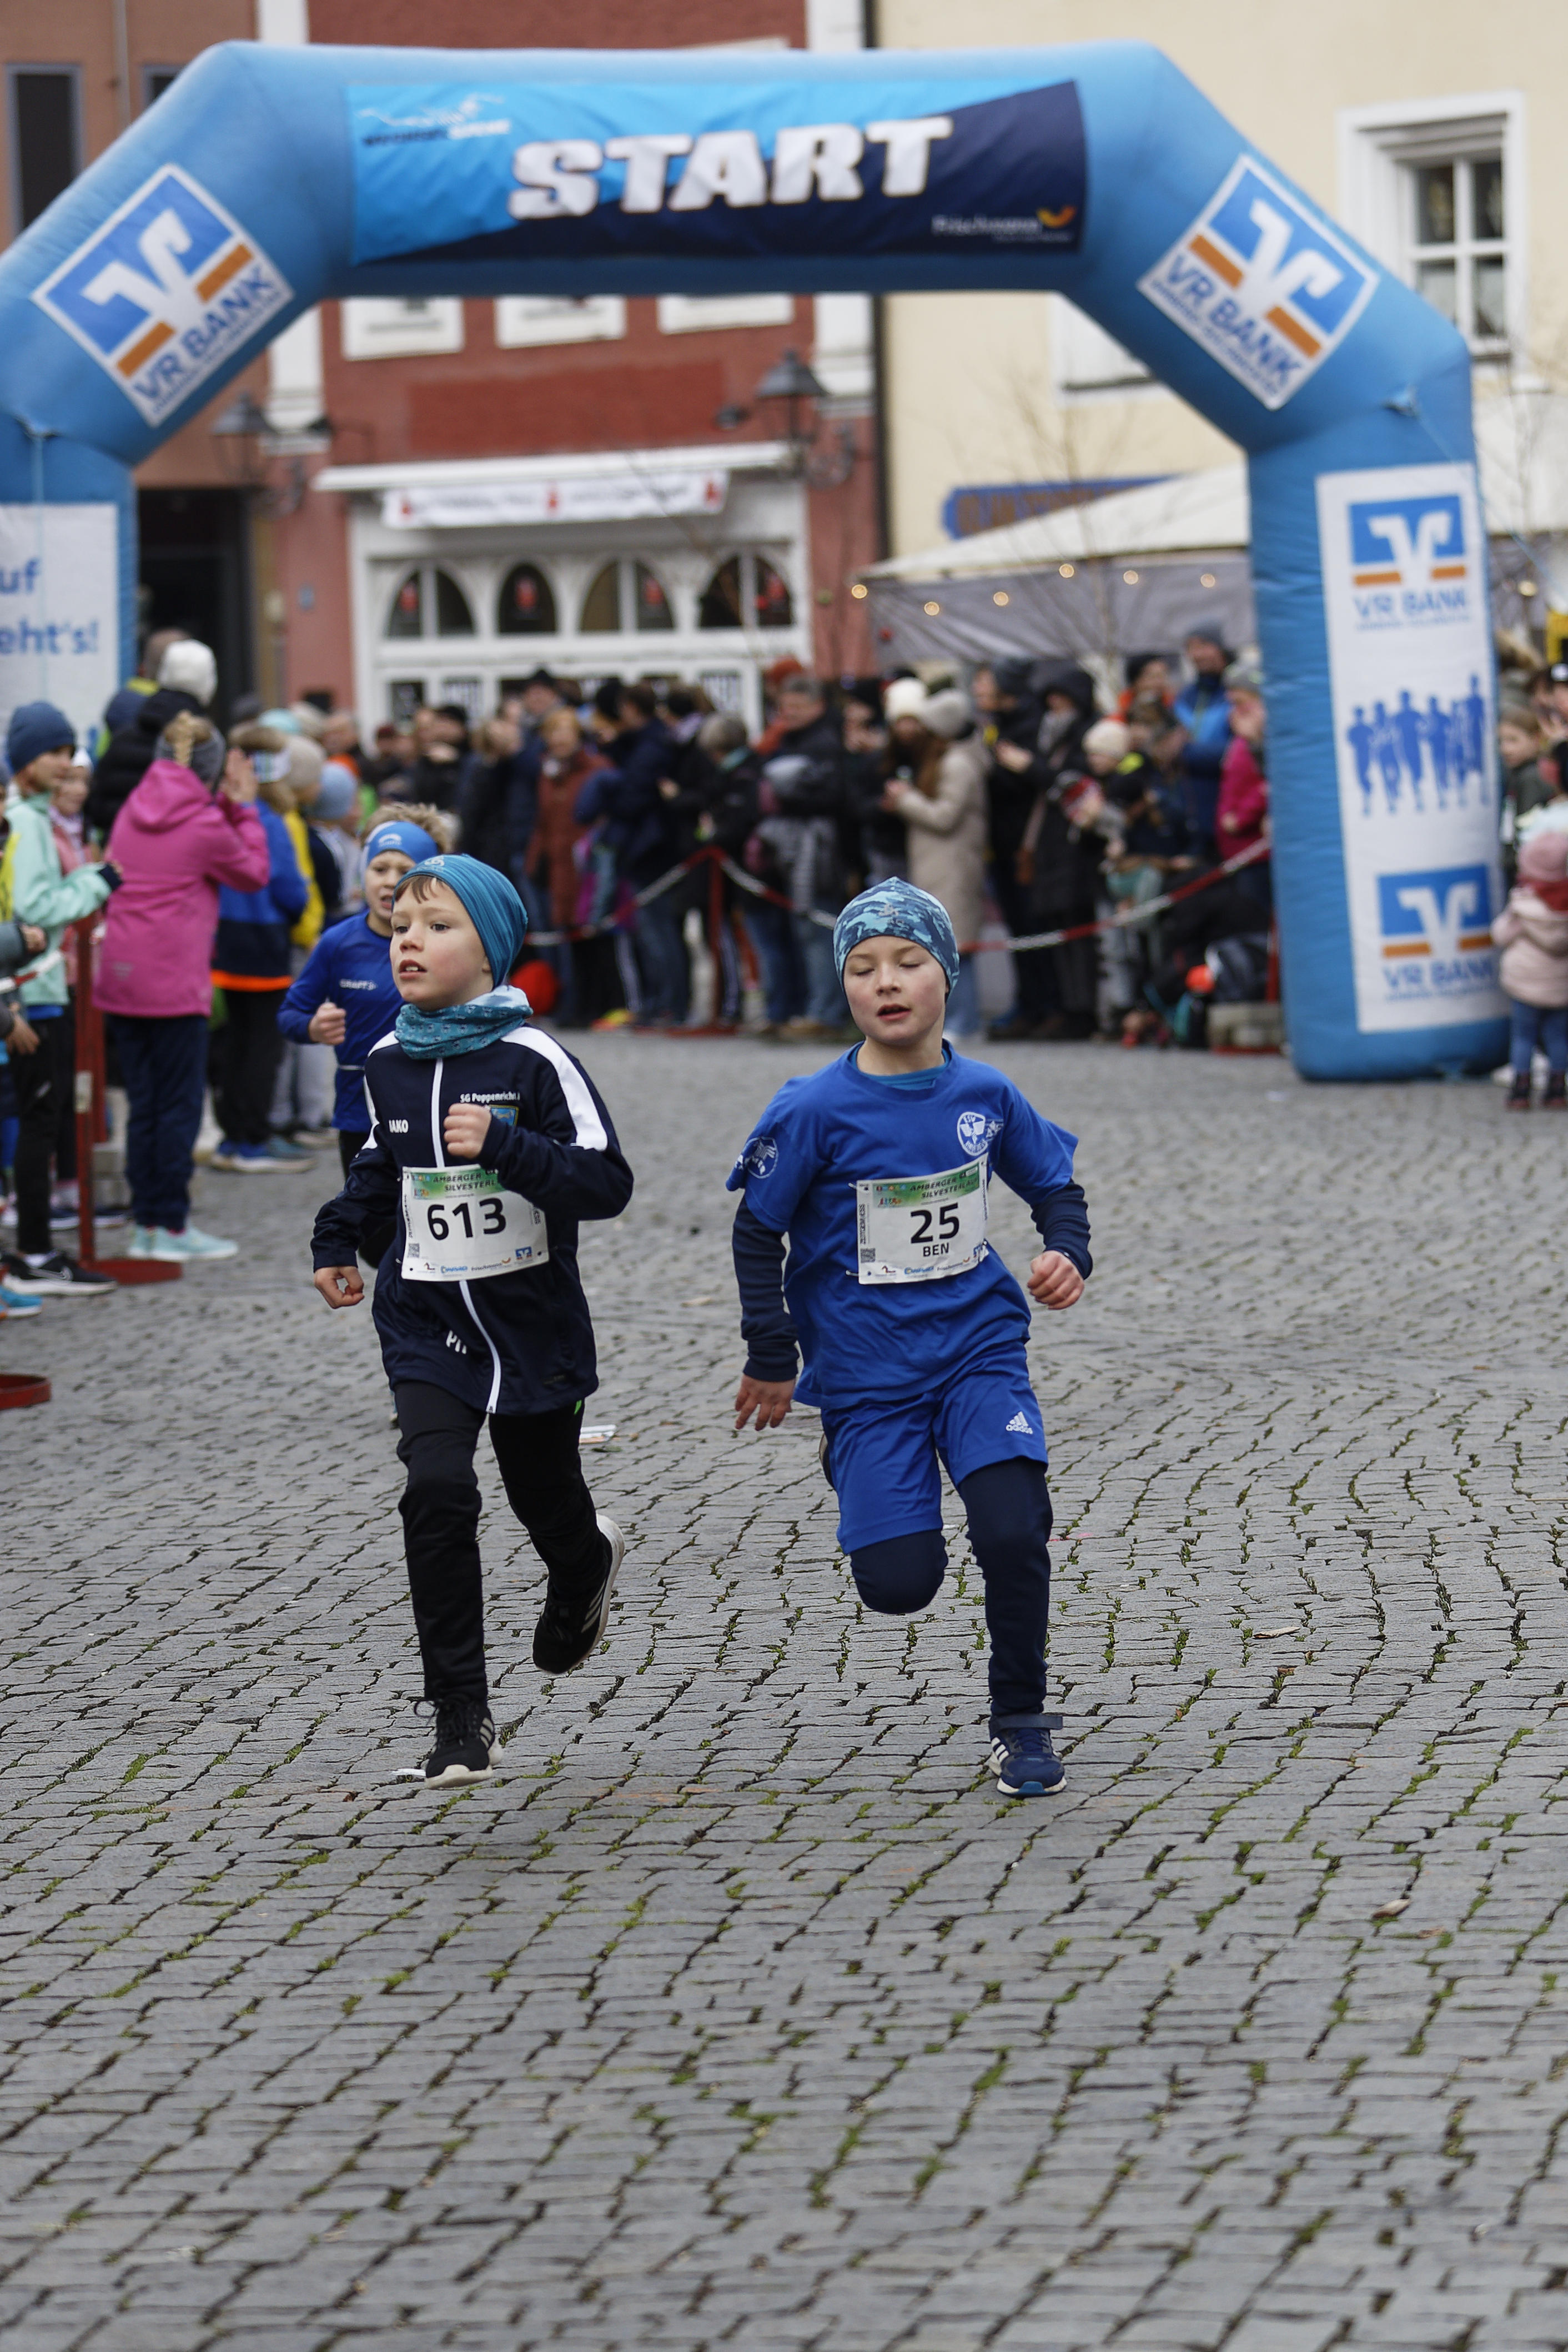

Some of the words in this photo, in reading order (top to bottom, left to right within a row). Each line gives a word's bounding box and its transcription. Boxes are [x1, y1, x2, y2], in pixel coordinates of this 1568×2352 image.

[507, 115, 954, 220] START
[132, 353, 184, 400] VR
[180, 265, 274, 359] BANK
[1167, 254, 1217, 308] VR
[1209, 298, 1303, 387] BANK
[1354, 591, 1393, 617] VR
[1401, 587, 1467, 615] BANK
[460, 1093, 471, 1103] SG
[433, 1172, 482, 1184] AMBERGER
[909, 1177, 957, 1192] AMBERGER
[427, 1197, 507, 1241] 613
[910, 1202, 960, 1244] 25
[923, 1242, 949, 1258] BEN
[1006, 1424, 1033, 1435] adidas
